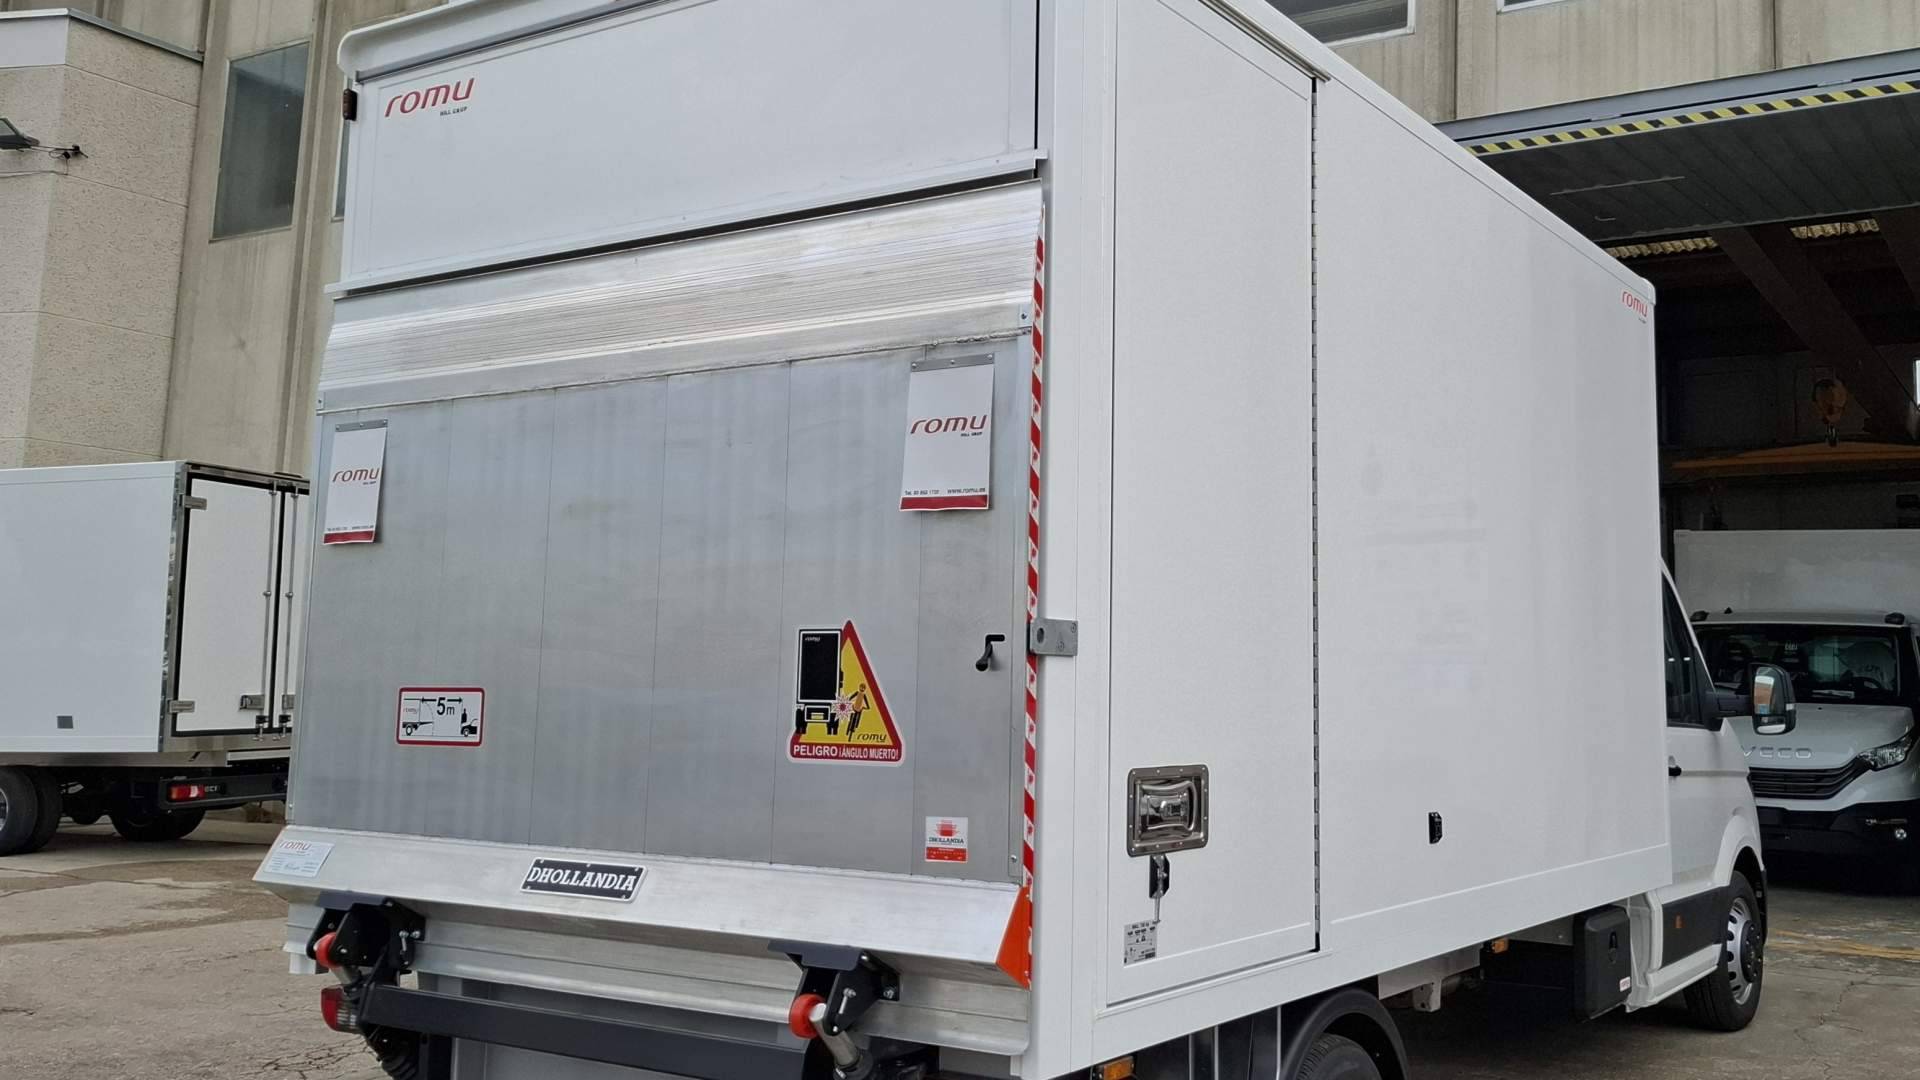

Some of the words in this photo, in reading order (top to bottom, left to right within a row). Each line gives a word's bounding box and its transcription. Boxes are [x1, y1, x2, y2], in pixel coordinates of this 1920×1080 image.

[384, 77, 475, 118] romu
[1622, 290, 1648, 318] romu
[910, 414, 988, 435] romu
[332, 467, 380, 483] romu
[793, 745, 838, 756] PELIGRO
[869, 748, 899, 760] MUERTO!
[1740, 745, 1812, 759] VECO
[526, 866, 638, 892] DHOLLANDIA
